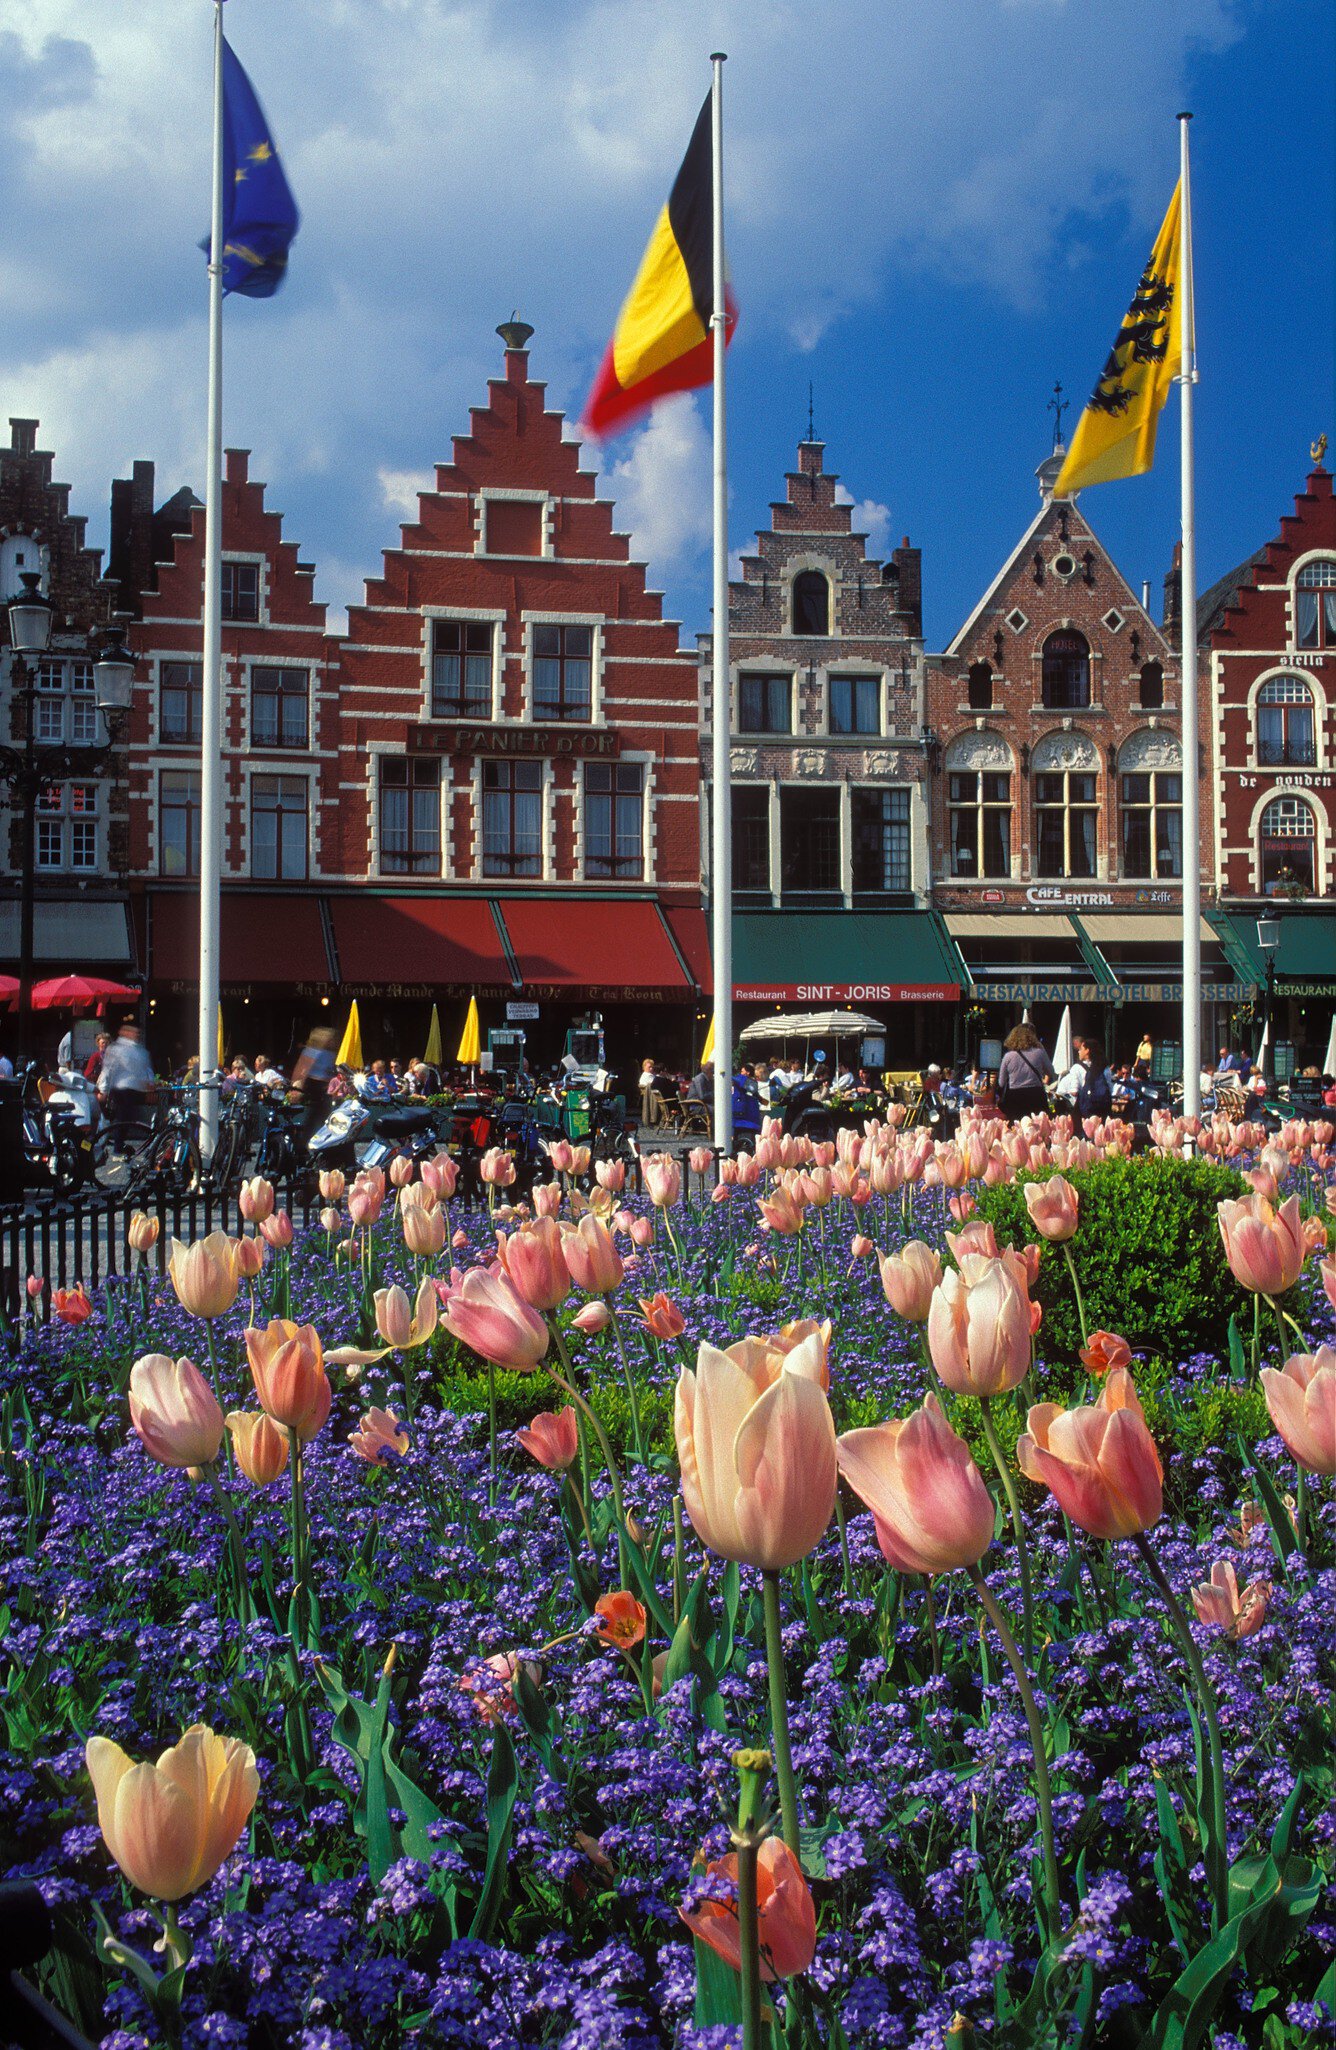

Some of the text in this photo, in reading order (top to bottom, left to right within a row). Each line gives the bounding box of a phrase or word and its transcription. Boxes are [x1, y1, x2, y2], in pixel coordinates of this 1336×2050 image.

[1279, 654, 1324, 667] stella
[416, 732, 448, 750] LE
[455, 730, 549, 752] PANIER
[1239, 774, 1332, 788] de gouden
[470, 984, 518, 999] Panie
[735, 990, 787, 1000] Restaurant
[900, 990, 945, 1000] Brasserie
[976, 984, 1251, 1001] RESTAURANT HOTEL BRSSERIE
